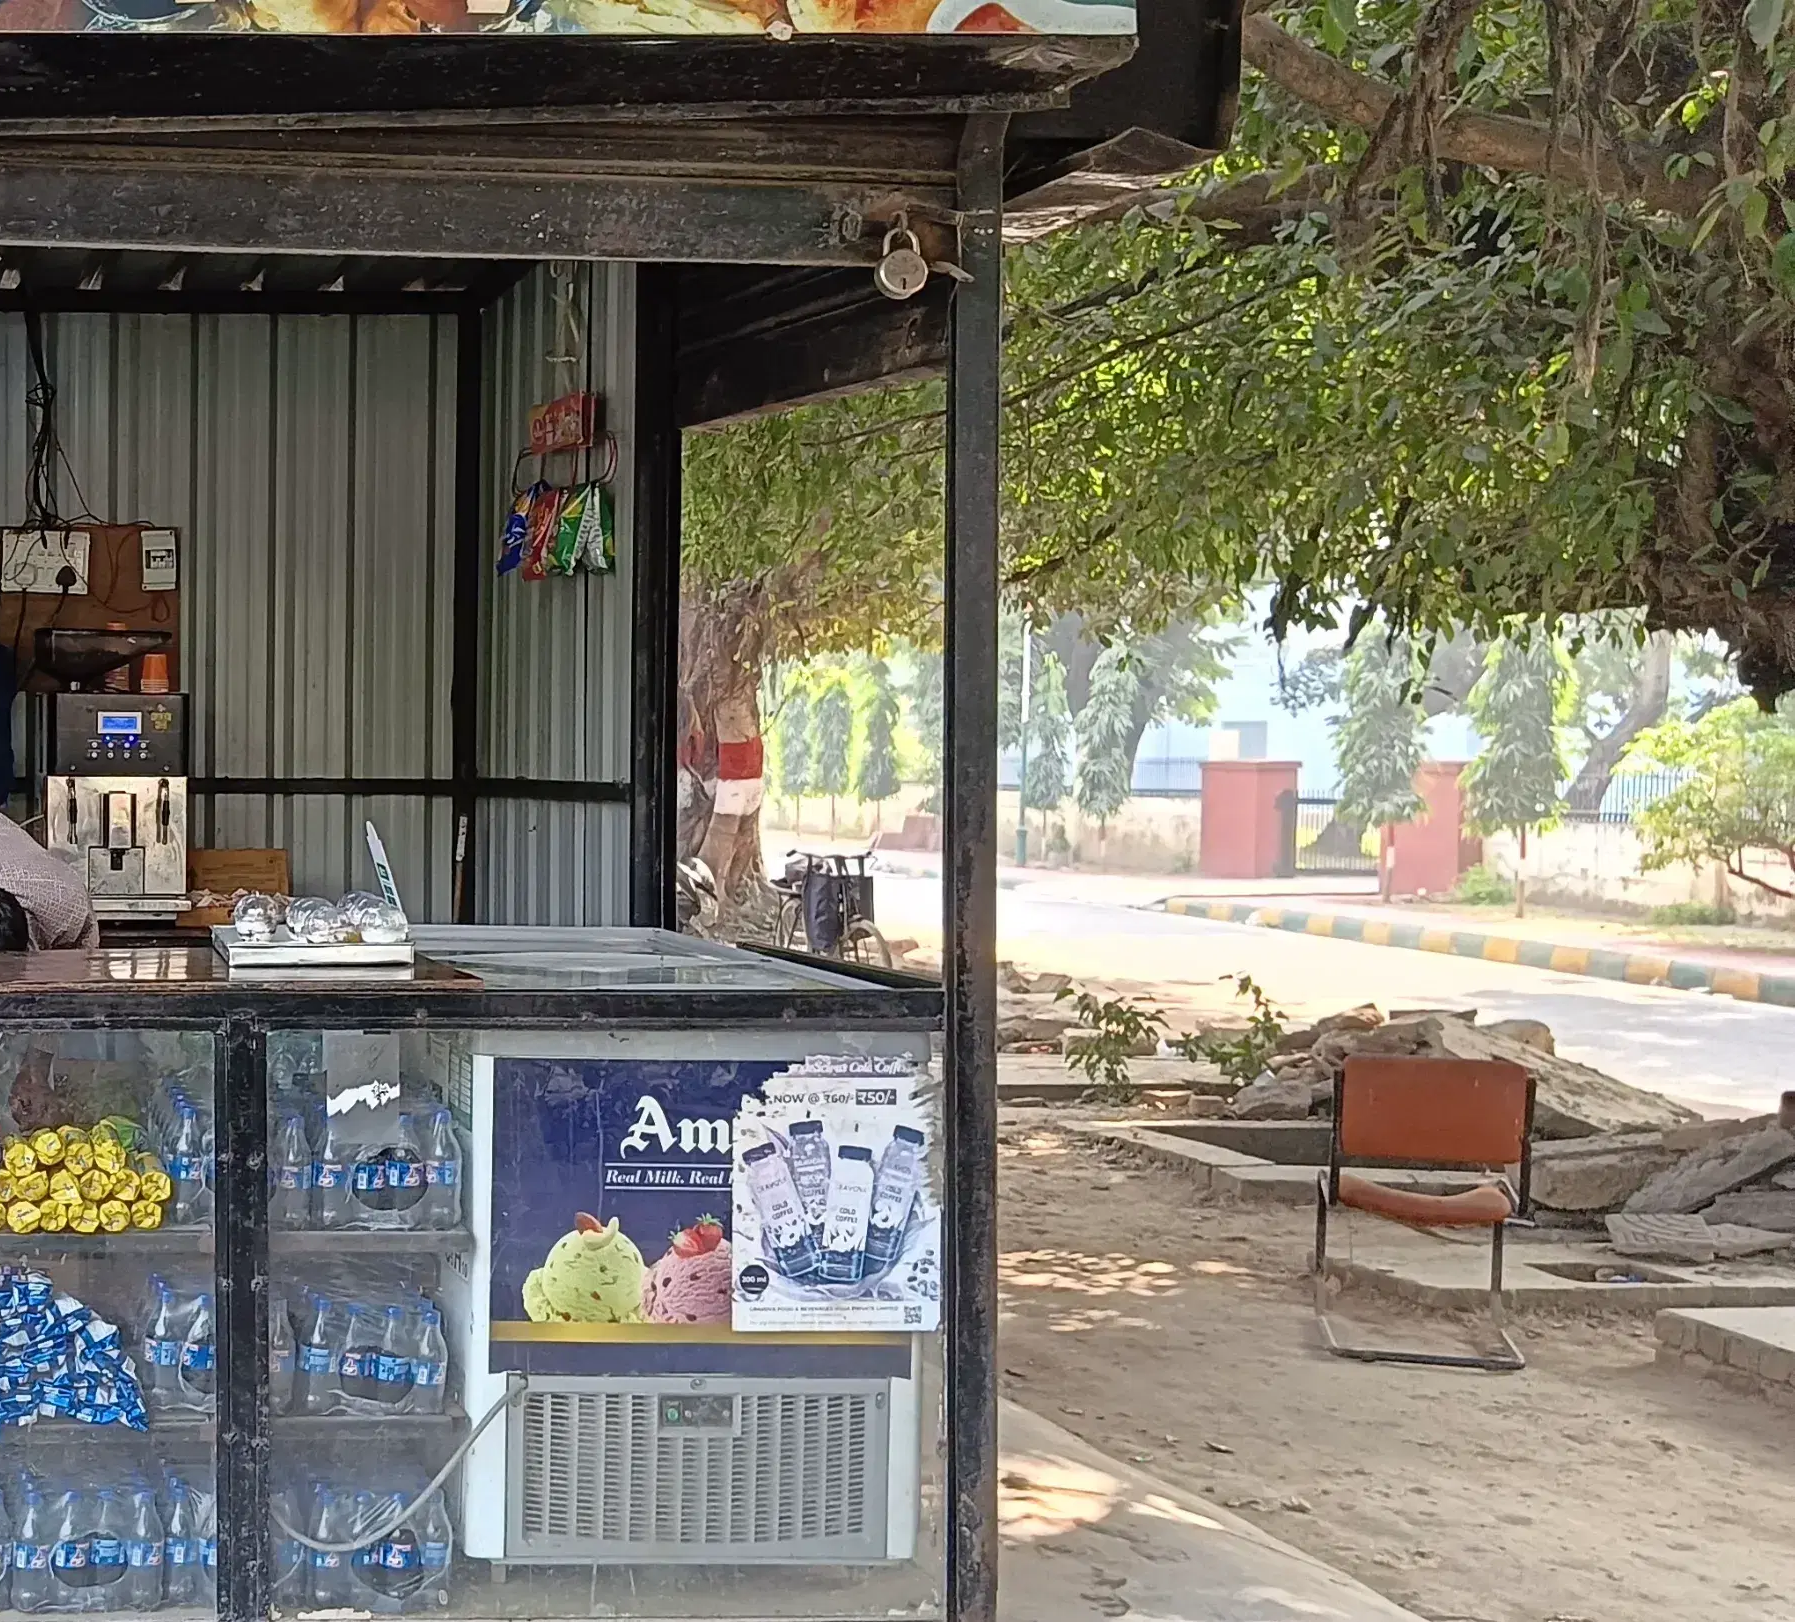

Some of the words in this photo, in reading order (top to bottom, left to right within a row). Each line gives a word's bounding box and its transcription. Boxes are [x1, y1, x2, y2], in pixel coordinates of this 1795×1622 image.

[774, 1093, 805, 1104] NOW
[807, 1092, 821, 1105] @
[605, 1169, 641, 1184] Real
[644, 1169, 685, 1185] Milk.
[689, 1170, 724, 1185] Real
